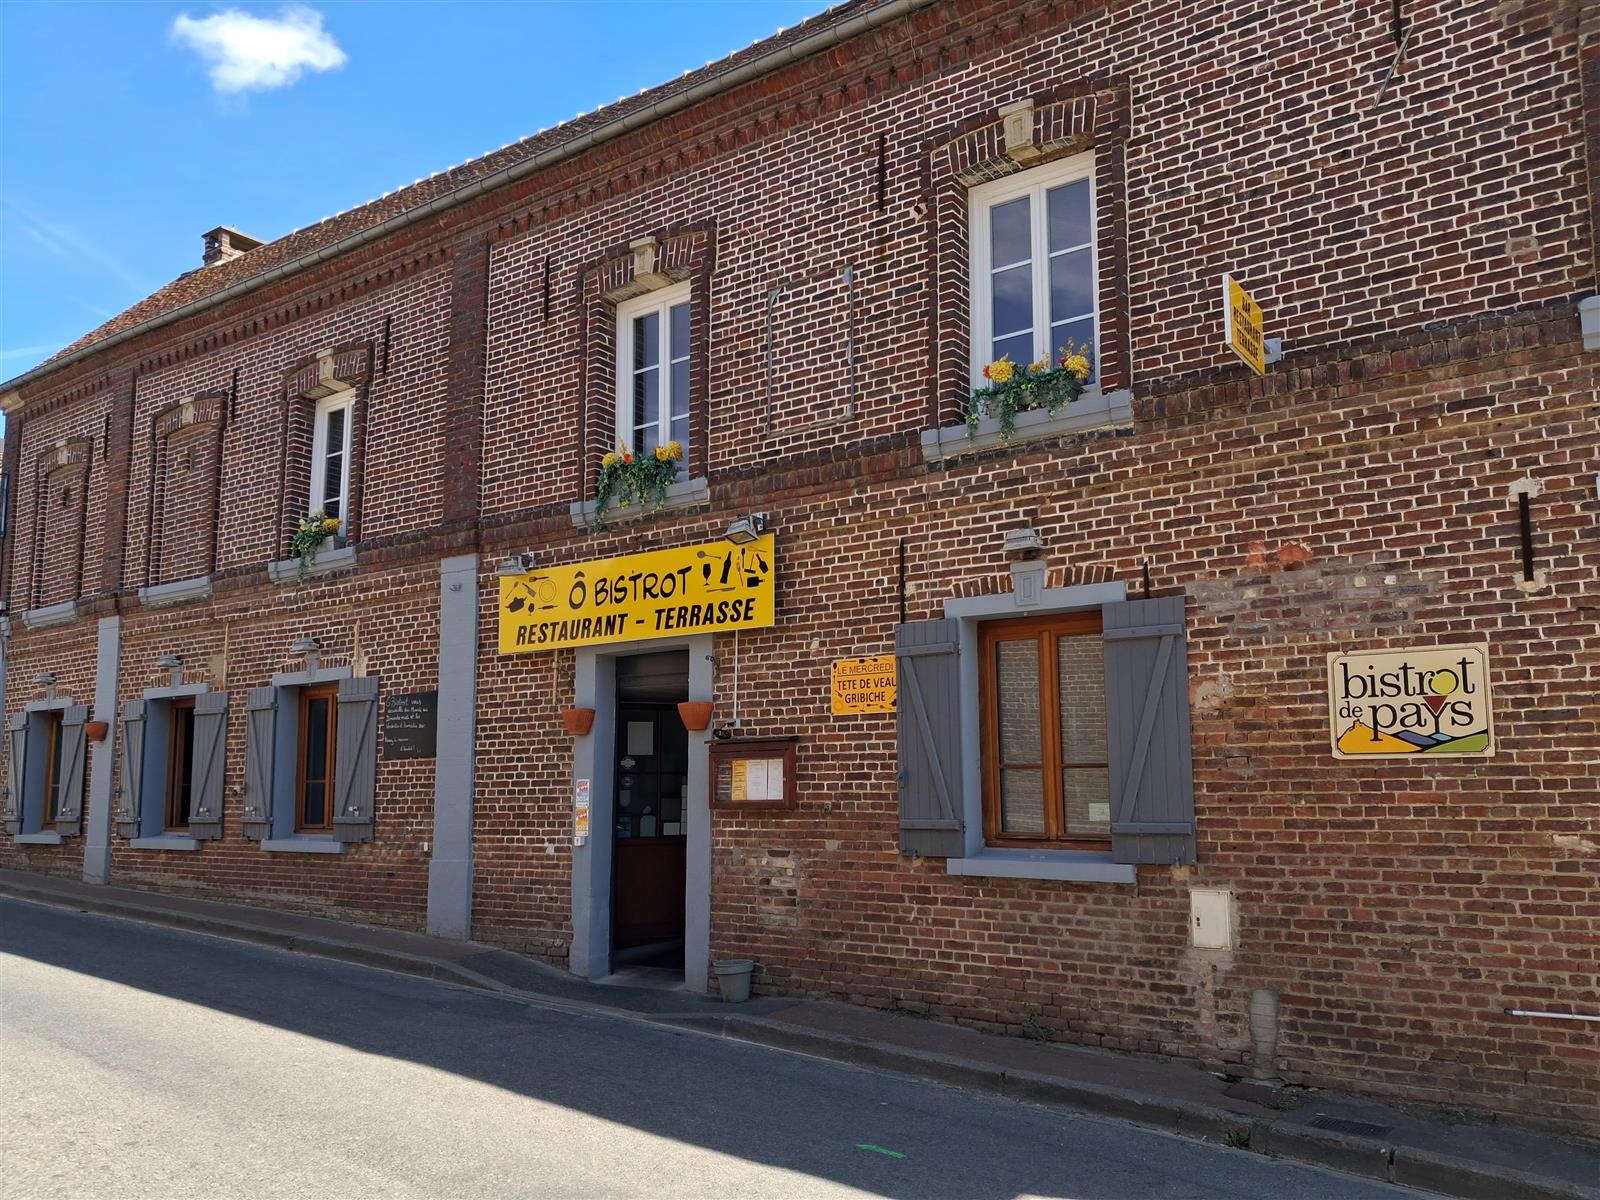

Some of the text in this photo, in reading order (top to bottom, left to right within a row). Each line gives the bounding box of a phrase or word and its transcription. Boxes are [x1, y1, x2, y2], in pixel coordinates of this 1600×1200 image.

[1233, 305, 1261, 346] RESTAURANT
[1236, 327, 1259, 362] TERRASSE
[568, 565, 692, 610] Ô BISTROT
[516, 612, 629, 646] RESTAURANT
[654, 597, 757, 631] TERRASSE
[837, 663, 894, 675] LE MERCREDI
[837, 677, 897, 690] TETE DE VEAU
[1339, 657, 1476, 700] bistrot
[844, 692, 886, 704] GRIBICHE
[1339, 700, 1475, 742] de pays
